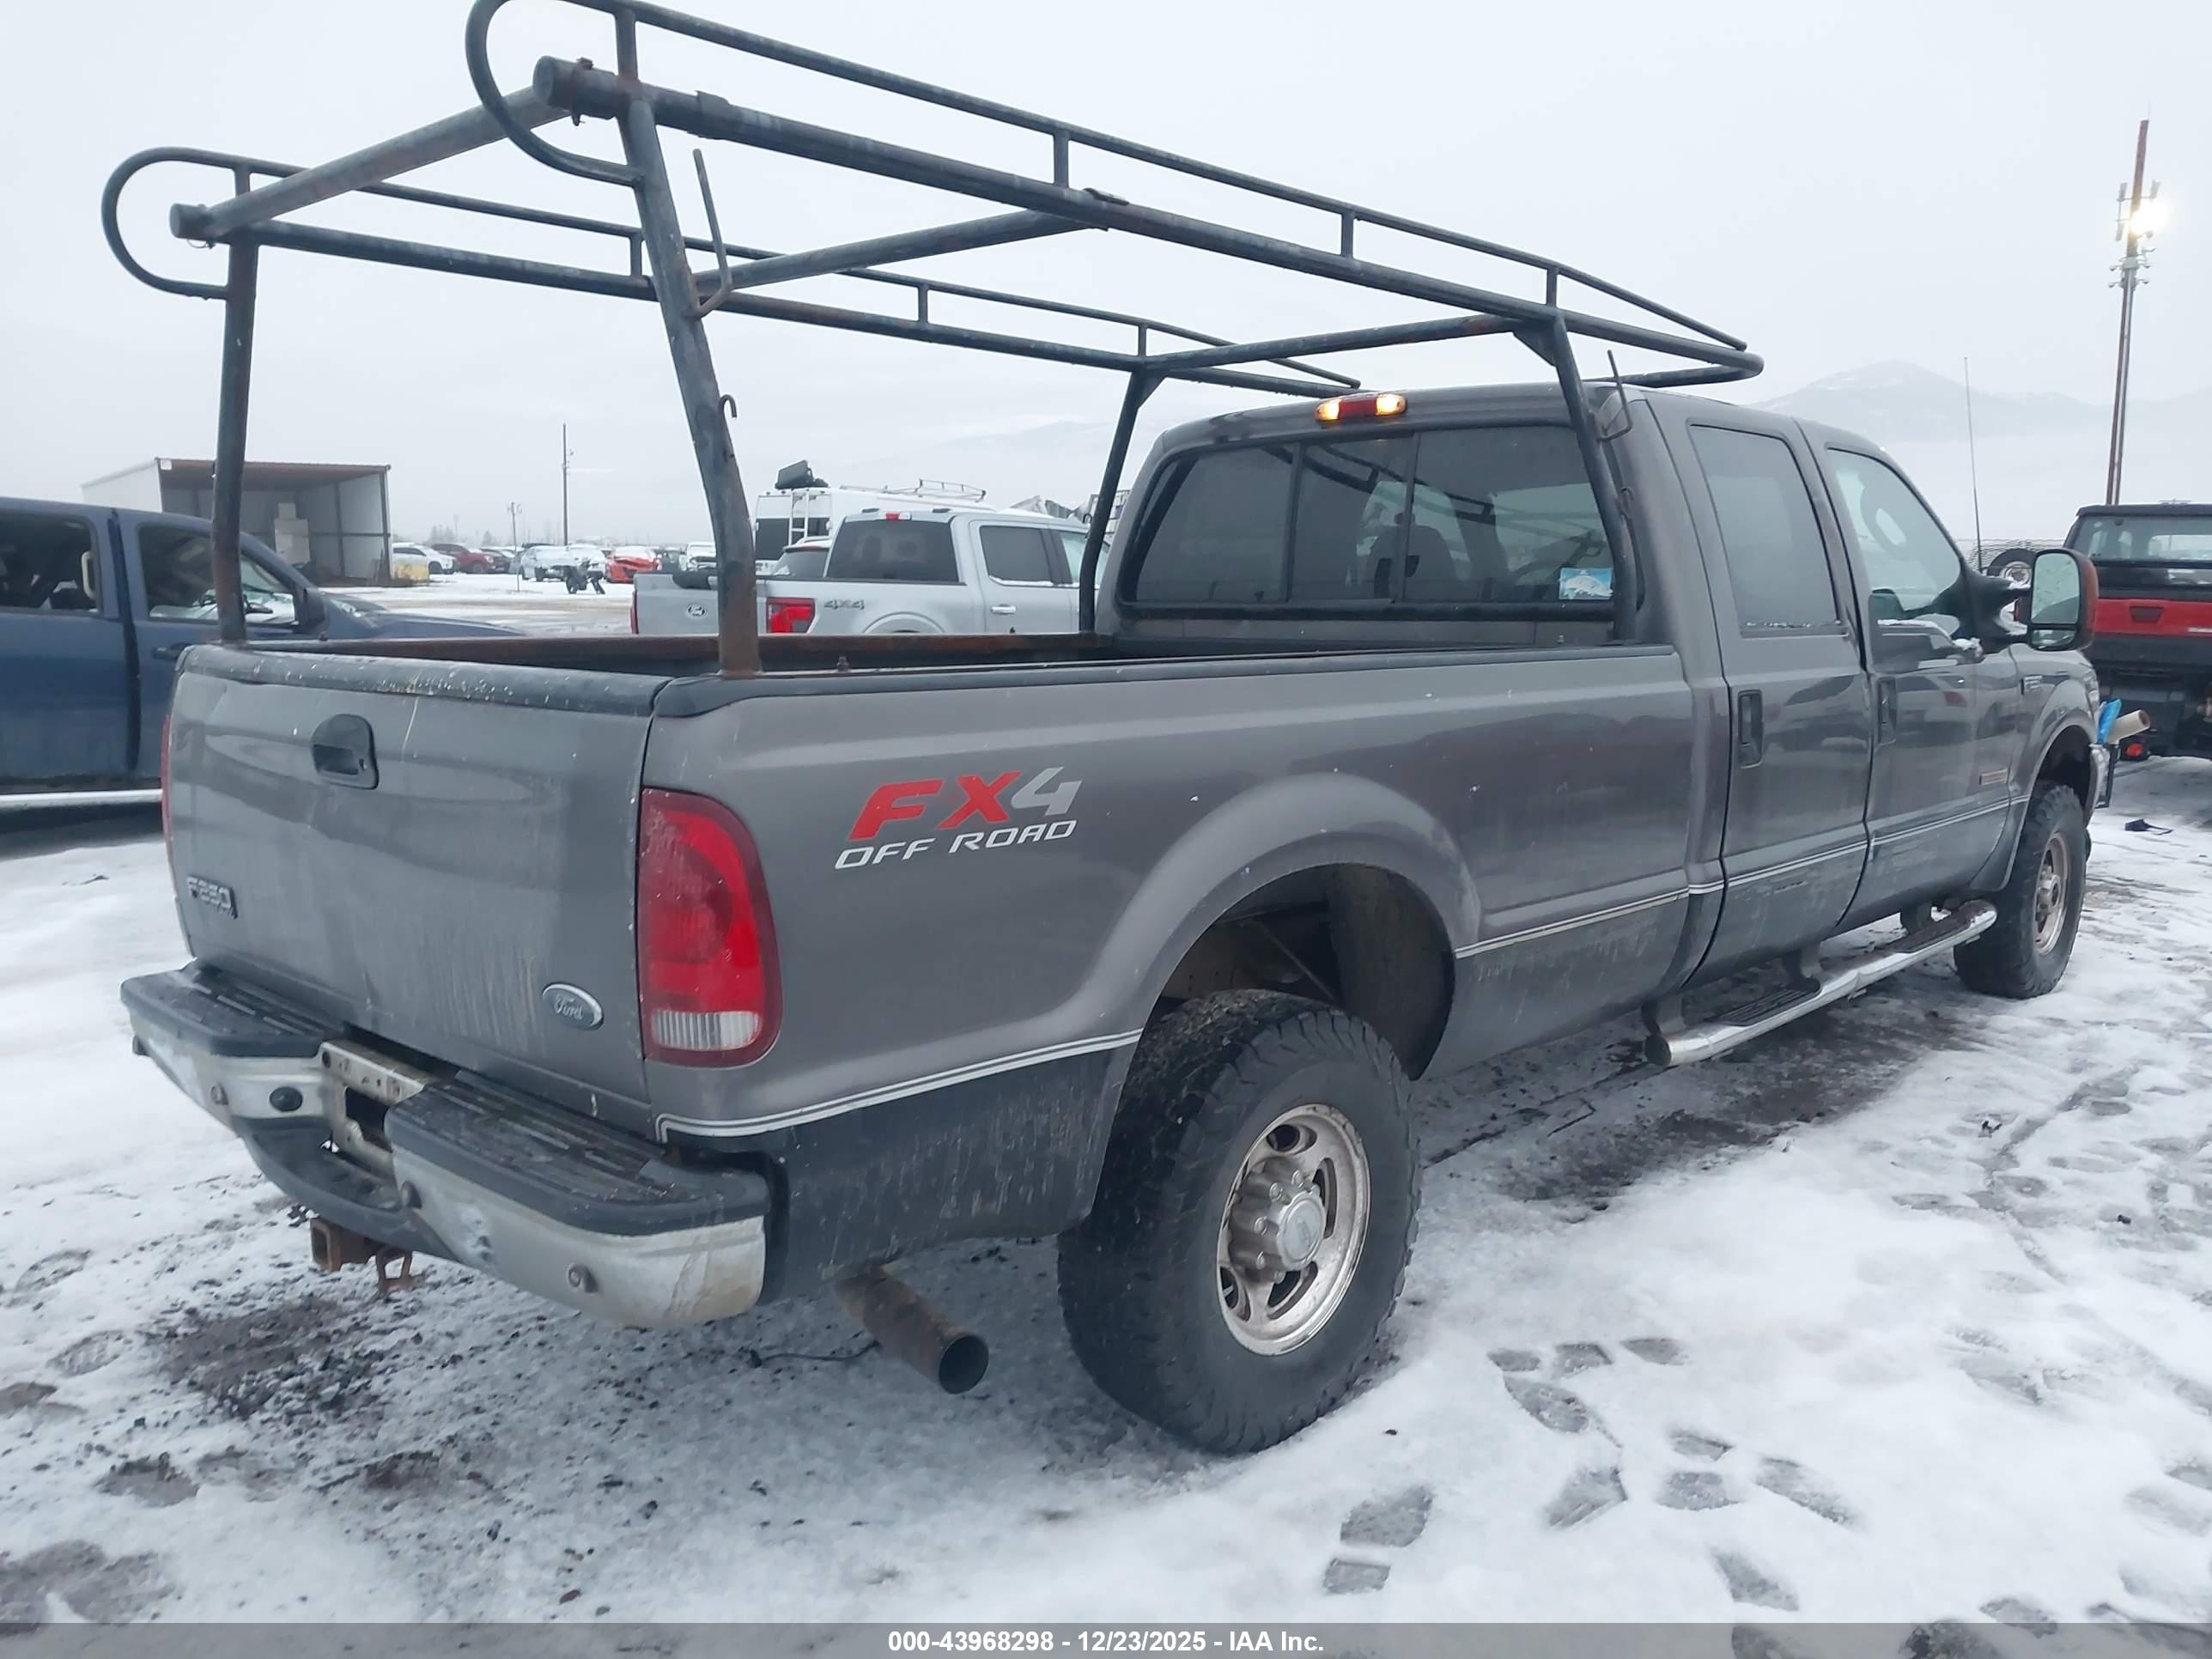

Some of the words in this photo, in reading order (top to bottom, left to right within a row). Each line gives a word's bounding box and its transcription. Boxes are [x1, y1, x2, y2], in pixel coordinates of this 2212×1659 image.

[847, 766, 1082, 842] FX4
[835, 837, 936, 870] OFF
[948, 819, 1077, 854] ROAD
